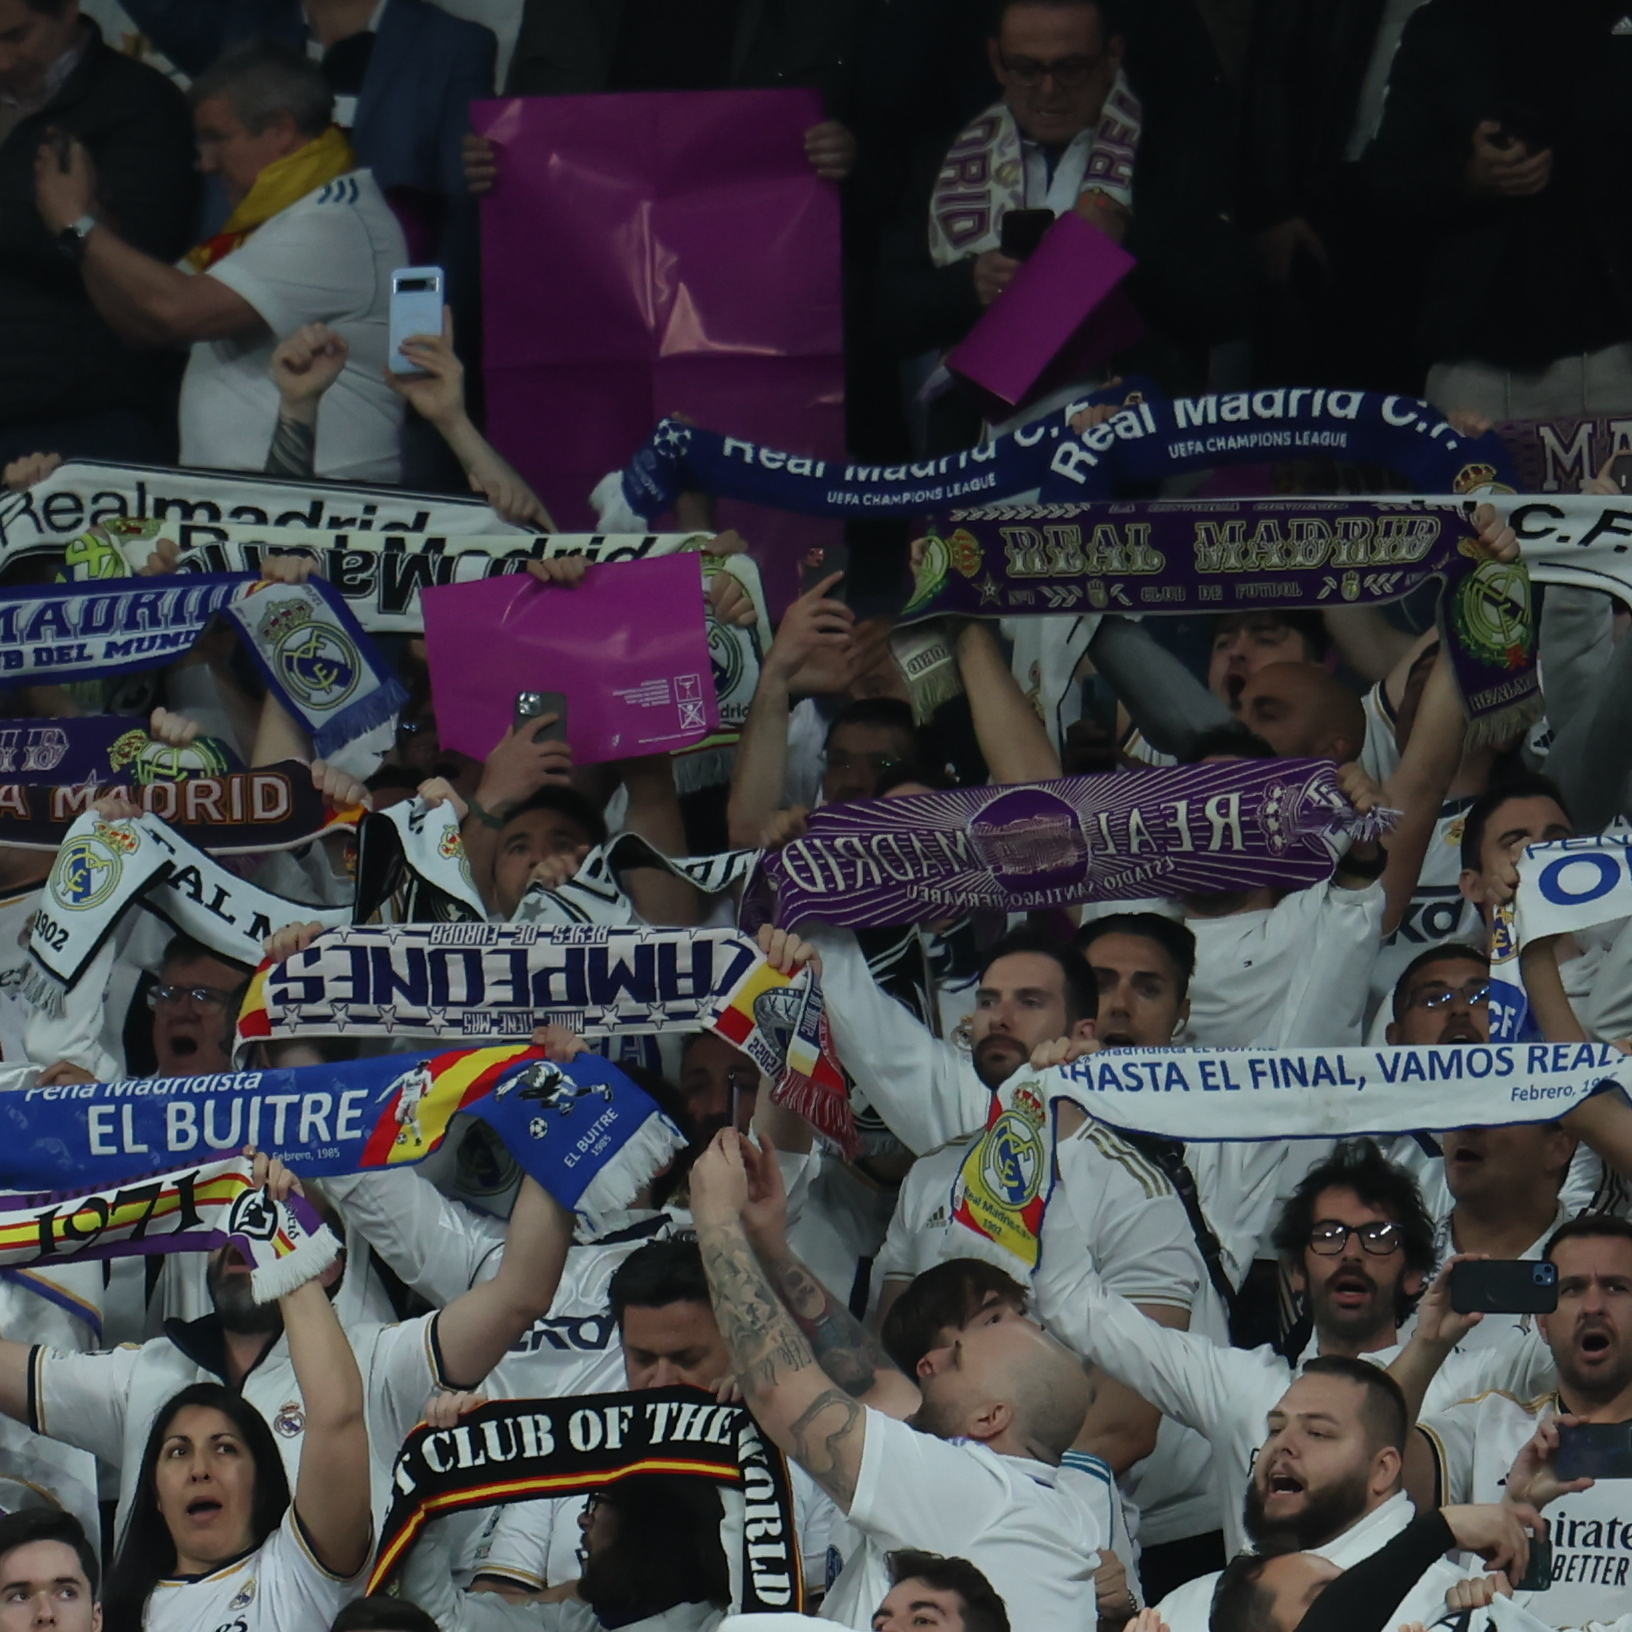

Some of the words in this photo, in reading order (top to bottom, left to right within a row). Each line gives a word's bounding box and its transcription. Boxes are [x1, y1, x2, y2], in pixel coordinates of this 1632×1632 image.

[1207, 429, 1291, 455] CHAMPIONS
[1295, 431, 1348, 450] LEAGUE
[826, 489, 859, 507] UEFA
[863, 485, 942, 508] CHAMPIONS
[946, 473, 997, 500] LEAGUE
[1000, 523, 1165, 577] REAL
[1194, 517, 1441, 572] MADRID
[34, 643, 93, 667] DEL
[50, 772, 294, 824] MADRID
[271, 938, 748, 1008] CAMPEONES
[1198, 1061, 1241, 1093] EL
[1248, 1055, 1367, 1094] FINAL,
[1374, 1045, 1515, 1083] VAMOS
[1510, 1081, 1577, 1103] Febrero,
[88, 1104, 158, 1157] EL
[164, 1088, 371, 1151] BUITRE
[576, 1107, 620, 1151] BUITRE
[36, 1172, 202, 1256] 1971
[422, 1413, 555, 1475] CLUB
[567, 1405, 634, 1451] OF
[644, 1400, 744, 1447] THE
